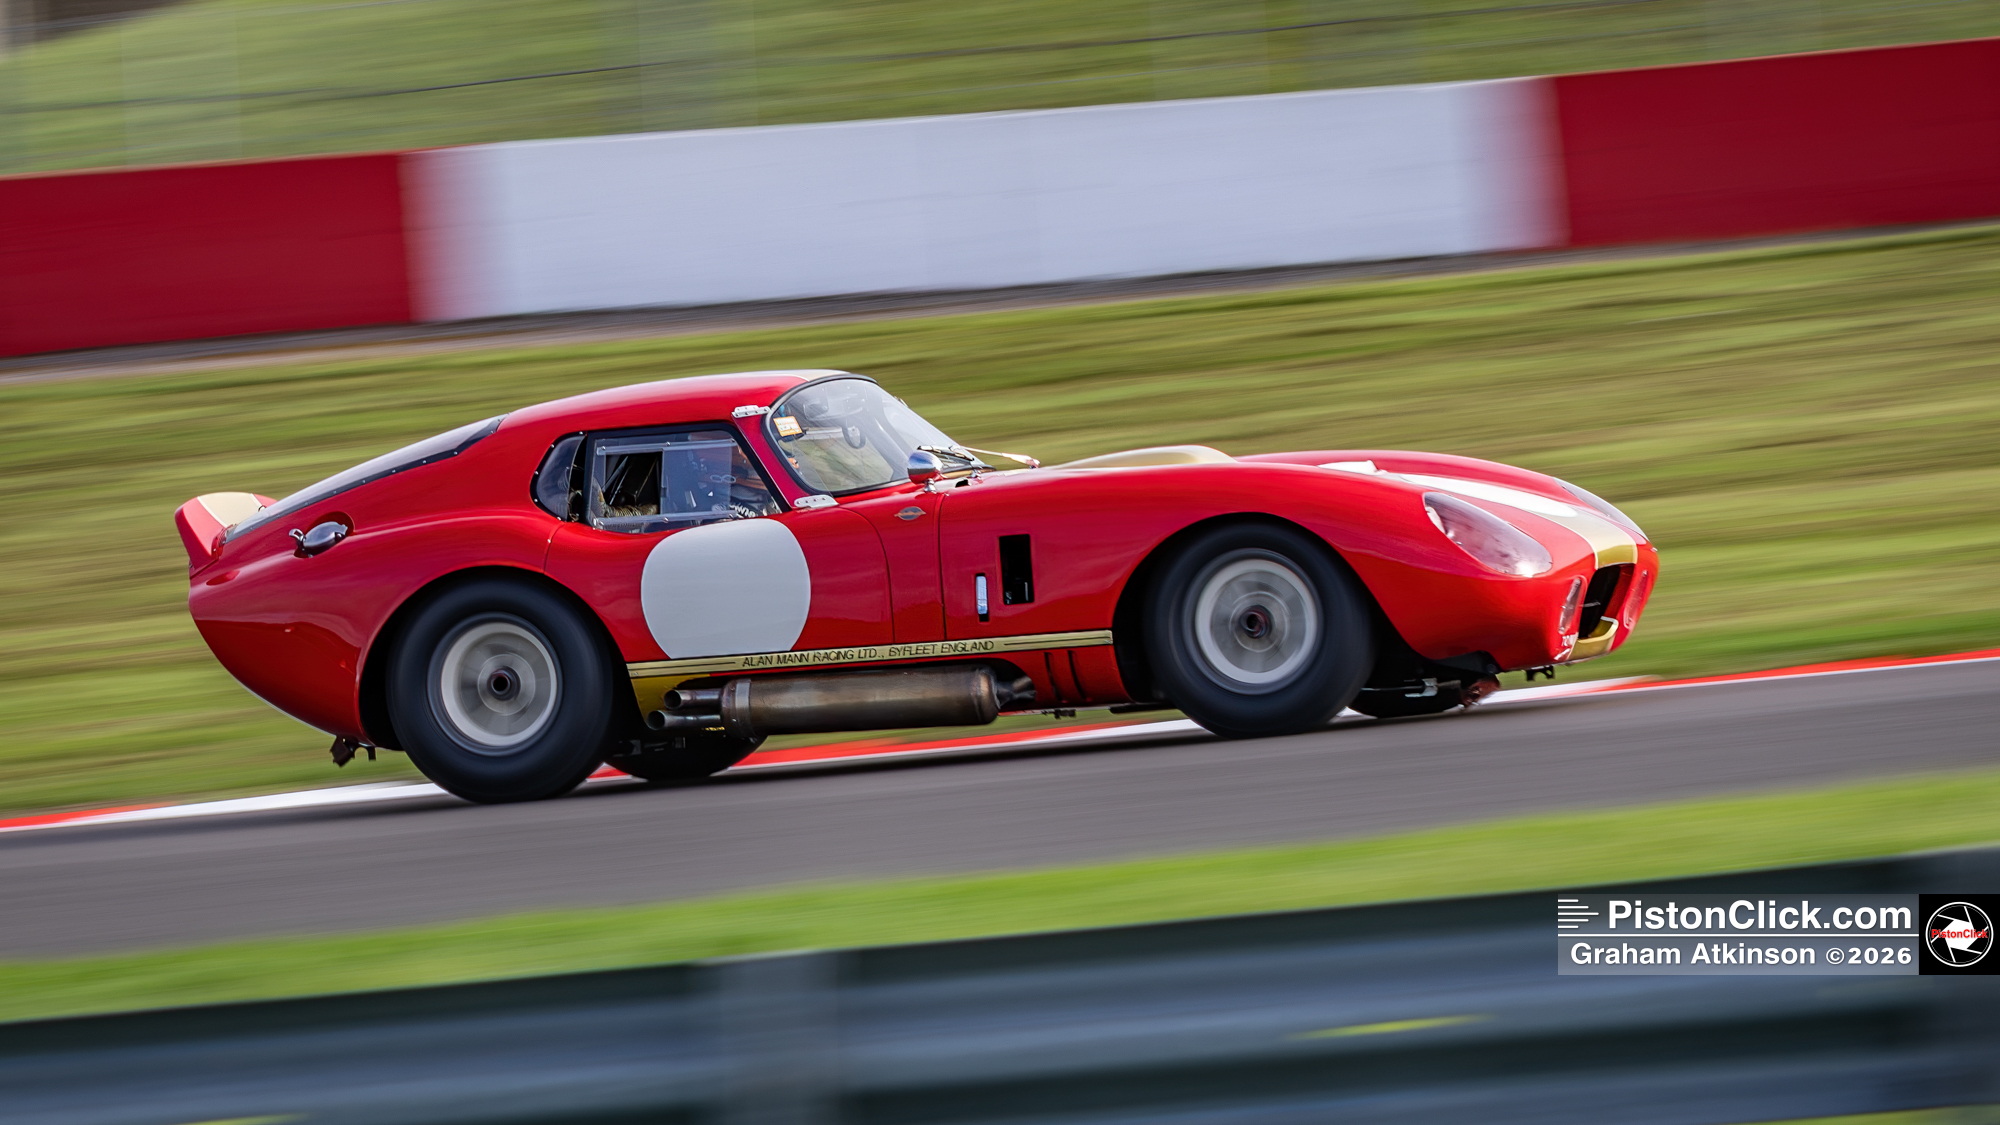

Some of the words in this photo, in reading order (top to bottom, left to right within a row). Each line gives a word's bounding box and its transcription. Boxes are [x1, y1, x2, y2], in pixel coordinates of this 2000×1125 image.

[742, 655, 774, 667] ALAN
[777, 652, 810, 665] MANN
[813, 649, 854, 662] RACING
[888, 643, 938, 657] BYFLEET
[940, 640, 995, 654] ENGLAND
